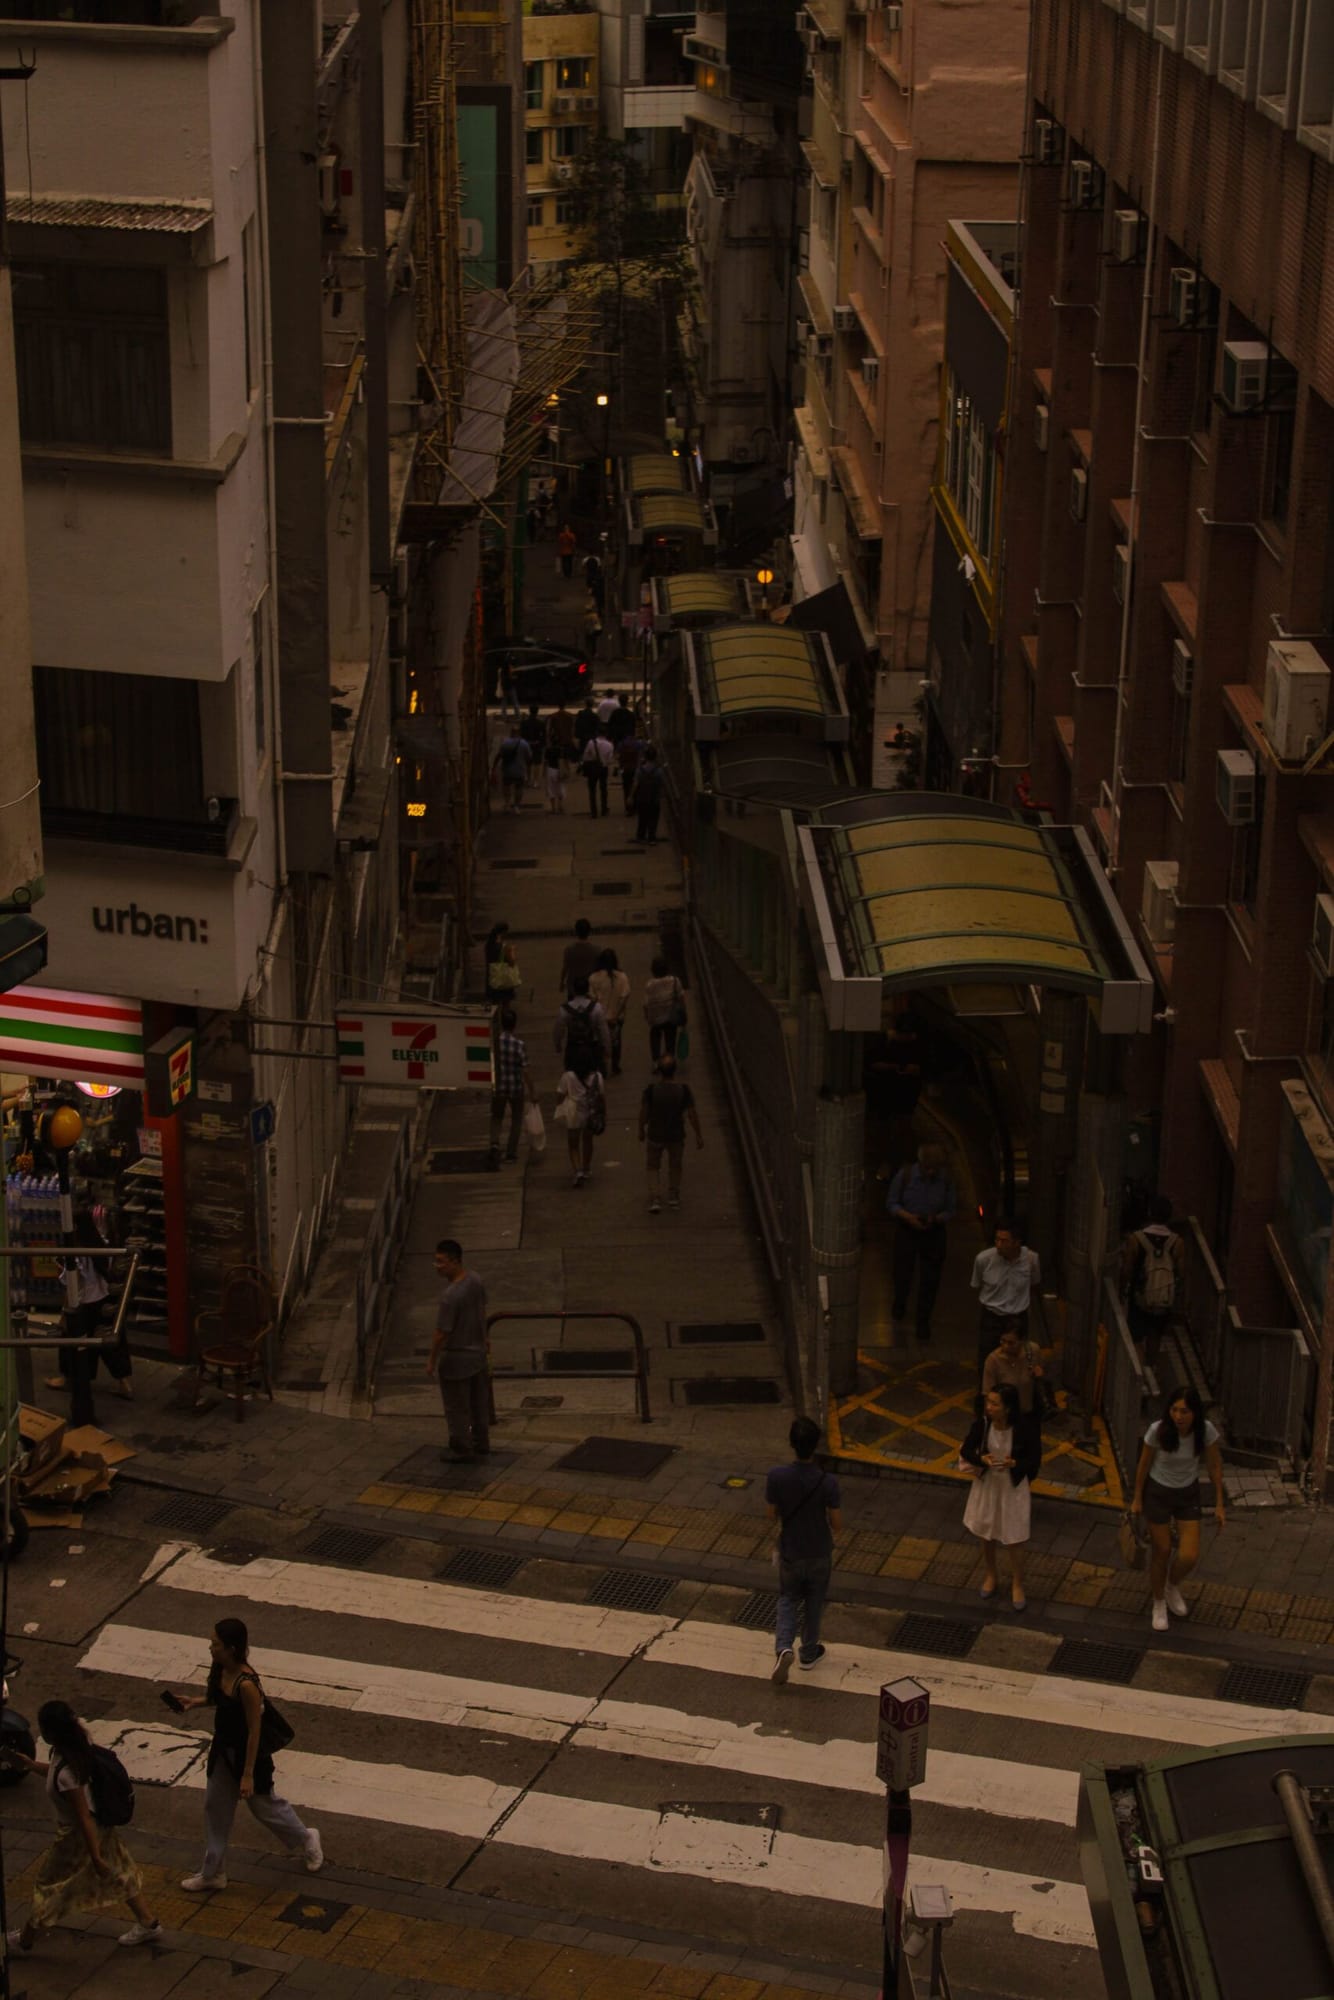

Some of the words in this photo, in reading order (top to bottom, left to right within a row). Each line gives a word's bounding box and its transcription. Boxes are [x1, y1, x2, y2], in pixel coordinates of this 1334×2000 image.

[92, 903, 208, 944] urban:
[171, 1048, 189, 1101] 7
[391, 1021, 437, 1080] 7
[906, 1730, 919, 1782] Central
